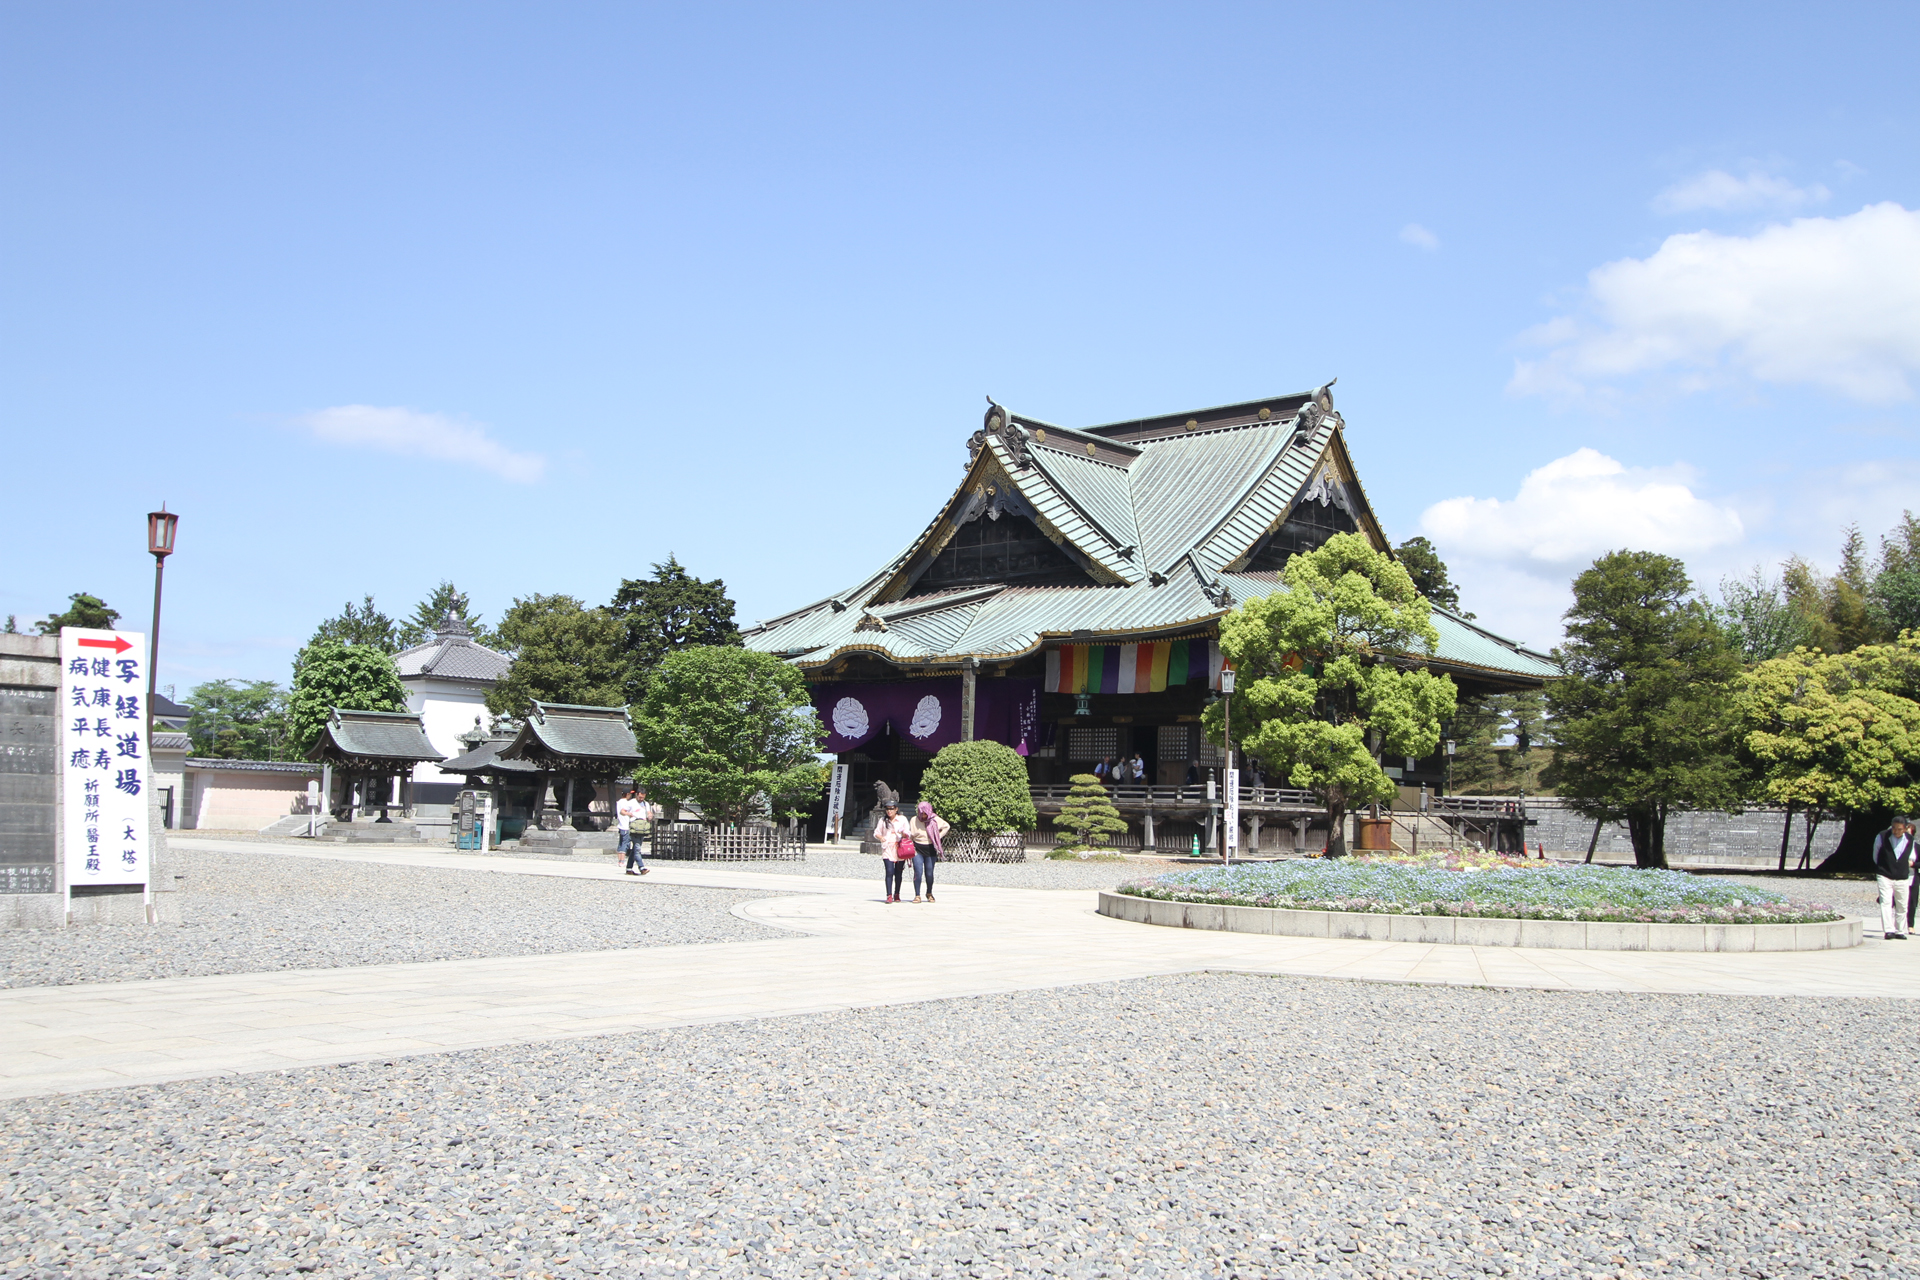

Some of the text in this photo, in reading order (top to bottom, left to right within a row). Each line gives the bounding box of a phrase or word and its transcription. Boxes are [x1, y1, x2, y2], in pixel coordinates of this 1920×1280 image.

[69, 656, 91, 769] 病気平癒
[91, 657, 112, 770] 健康長寿
[115, 659, 142, 796] 写経道場
